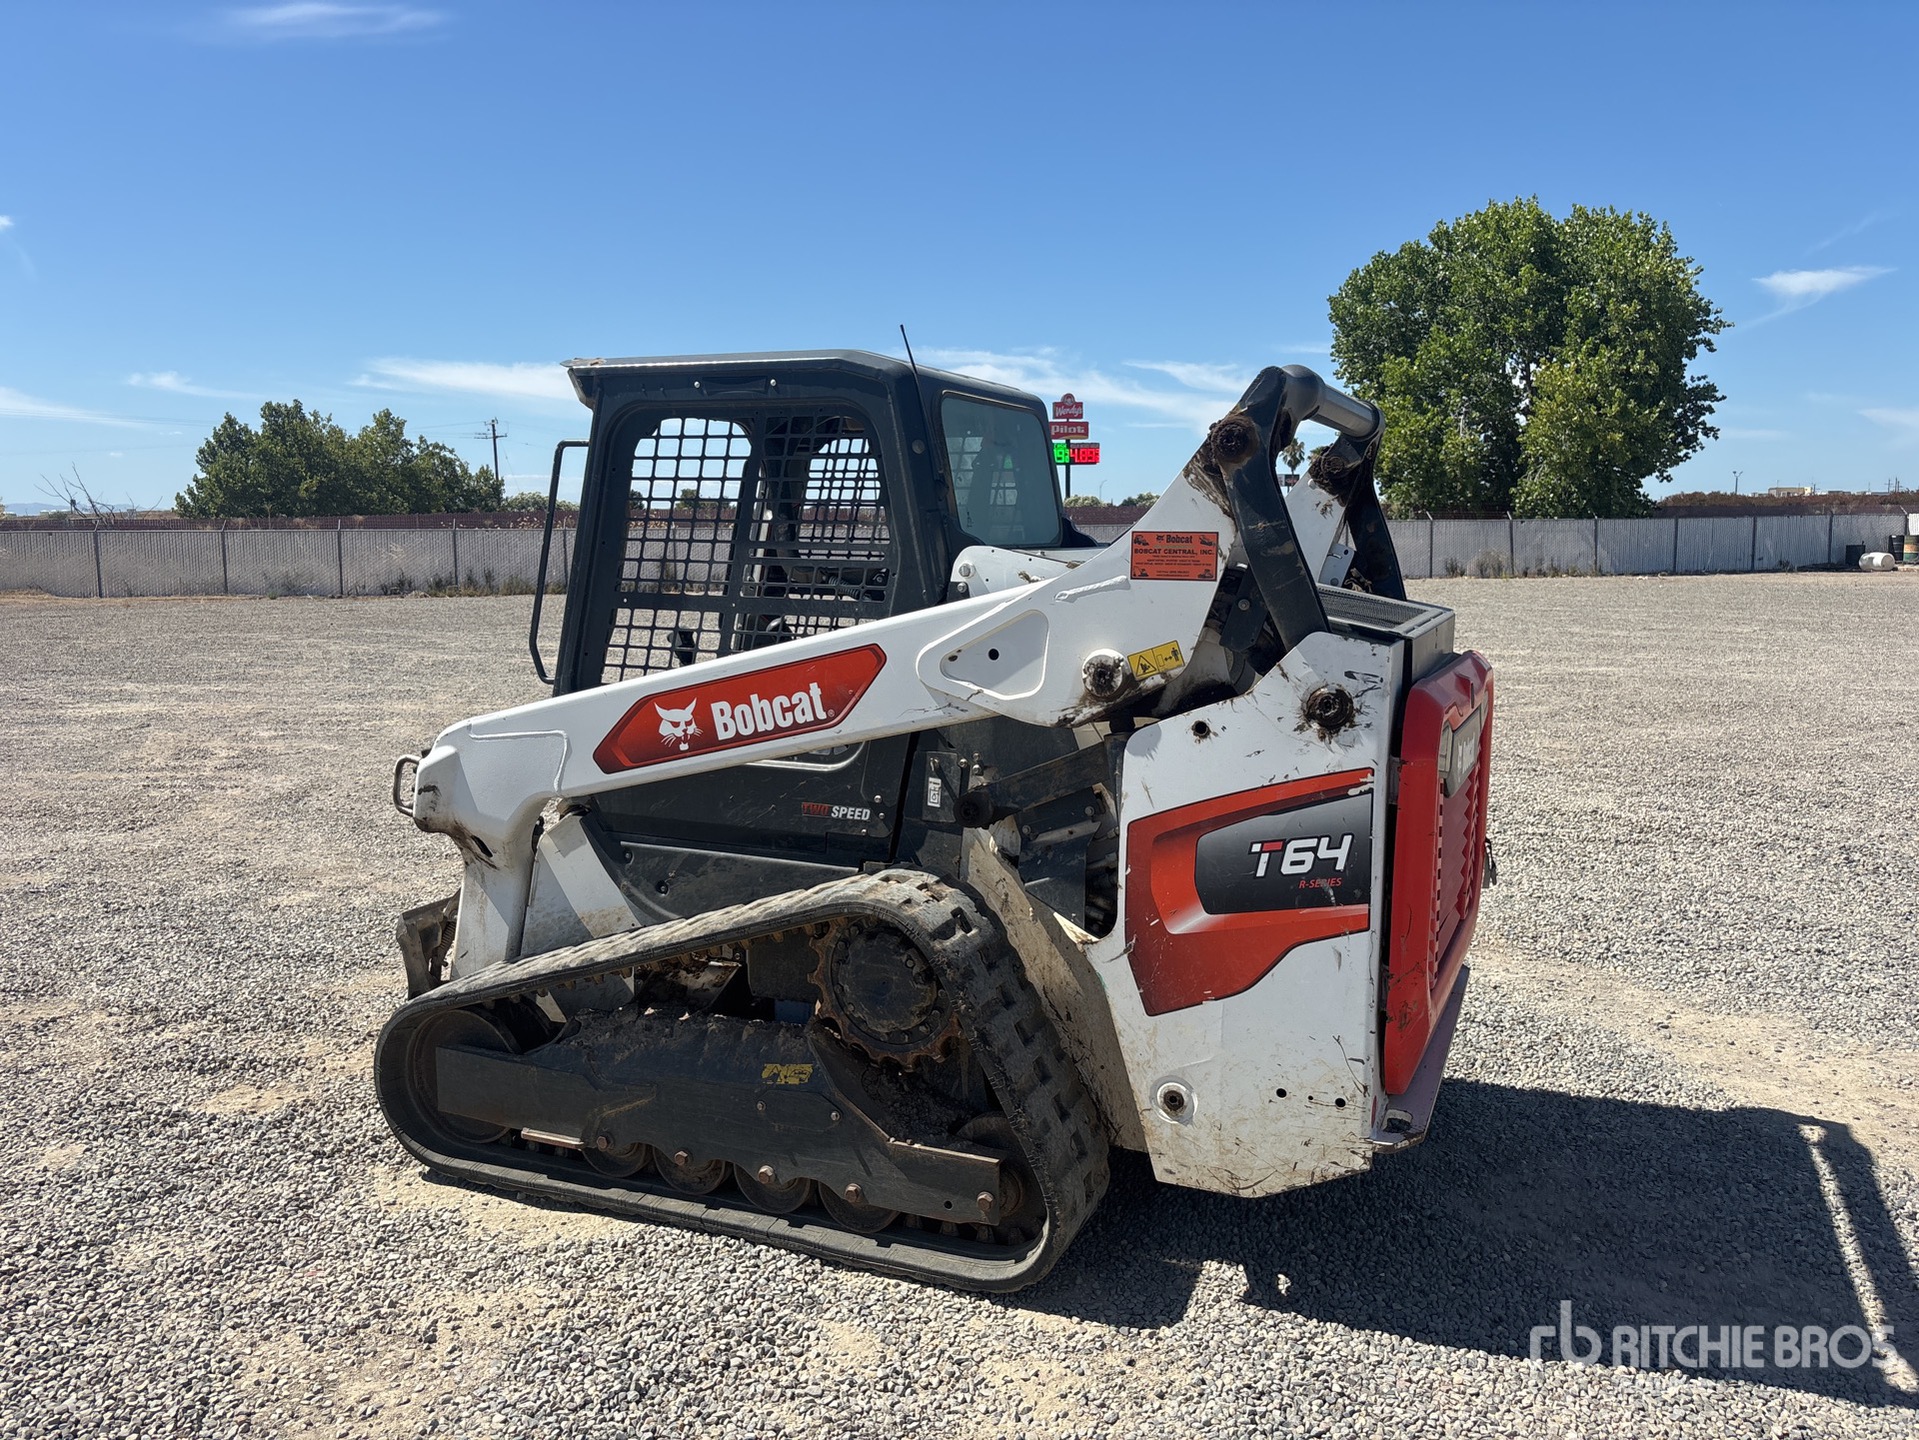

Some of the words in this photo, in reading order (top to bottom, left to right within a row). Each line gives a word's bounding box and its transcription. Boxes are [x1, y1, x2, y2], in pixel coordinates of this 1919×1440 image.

[1051, 425, 1085, 435] Pilot
[1166, 534, 1193, 543] Bobcat
[711, 682, 827, 741] Bobcat
[802, 802, 830, 816] TWO
[831, 805, 871, 821] SPEED
[1251, 834, 1353, 878] T64
[1299, 877, 1342, 889] R-SERIES
